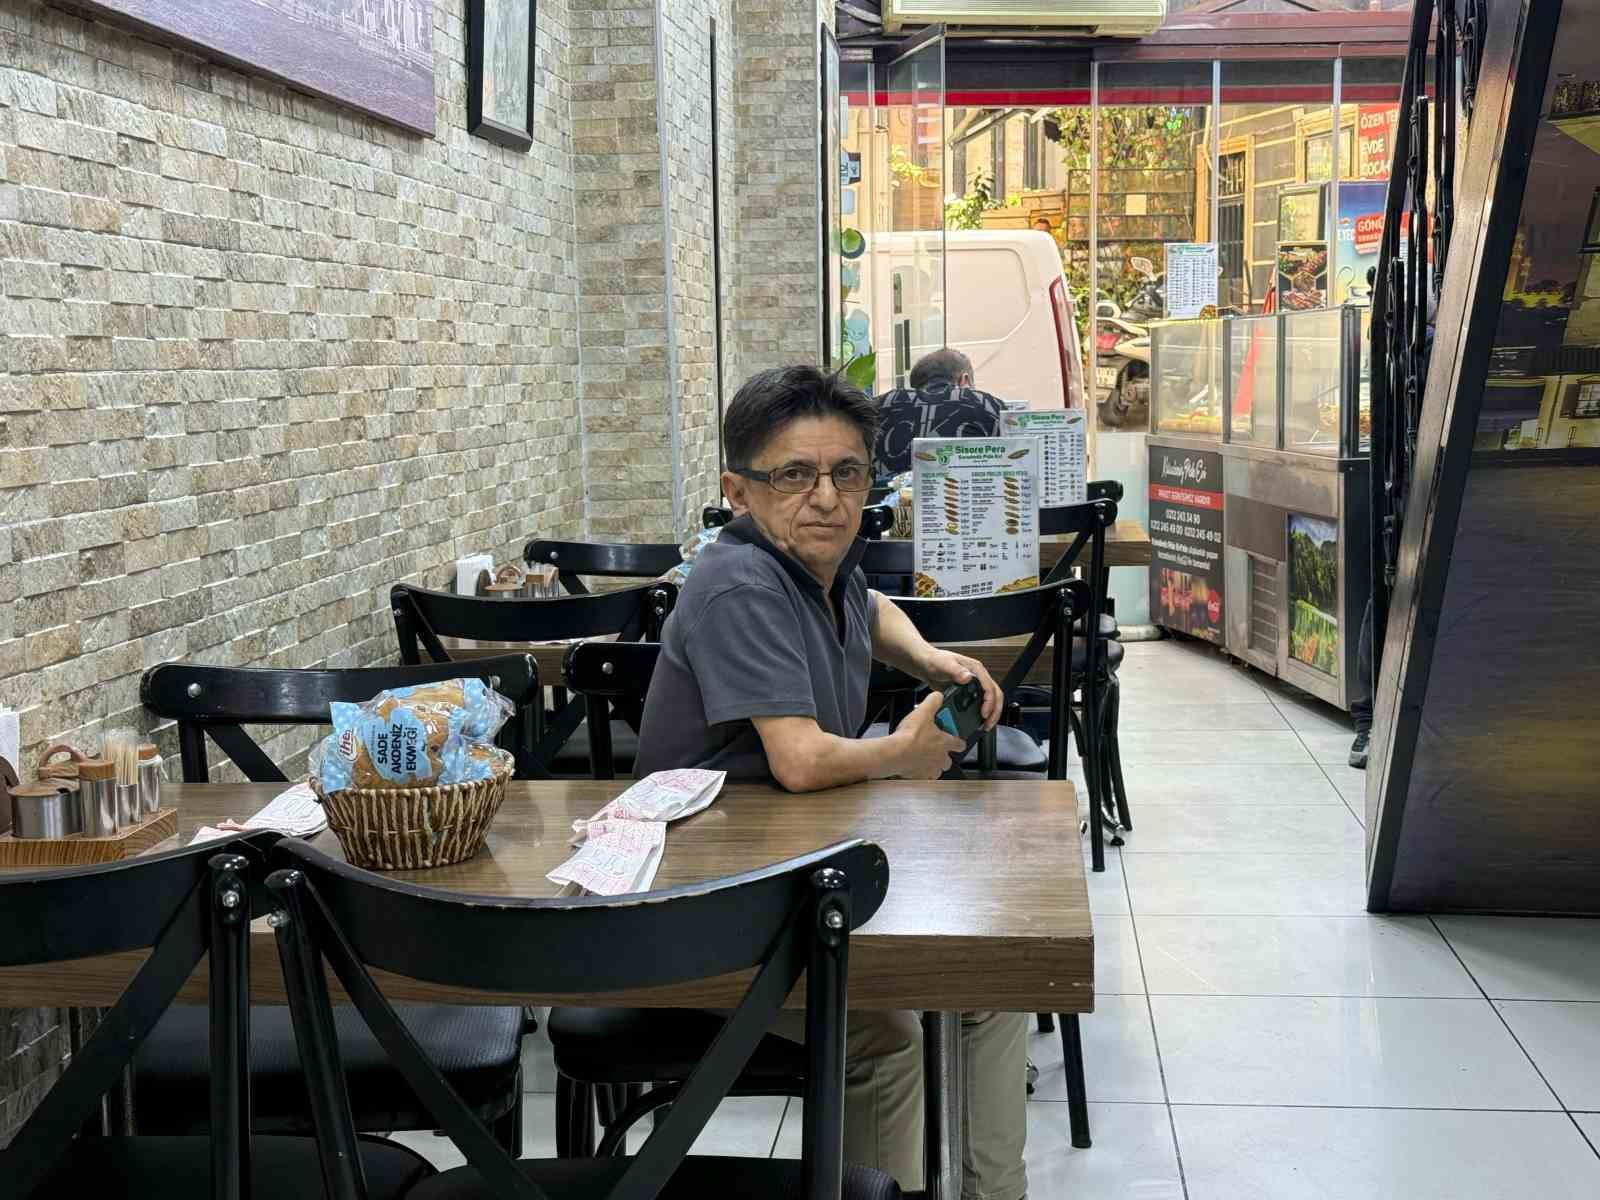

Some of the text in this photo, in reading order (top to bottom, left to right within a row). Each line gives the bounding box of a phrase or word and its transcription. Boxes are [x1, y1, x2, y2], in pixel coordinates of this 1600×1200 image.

[1360, 112, 1385, 129] ÖZEN
[1361, 138, 1385, 155] EVDE
[955, 445, 1006, 454] Sisore Pera
[377, 732, 388, 764] SADE
[390, 723, 402, 774] AKDENİZ
[403, 727, 418, 771] EKMEĞİ
